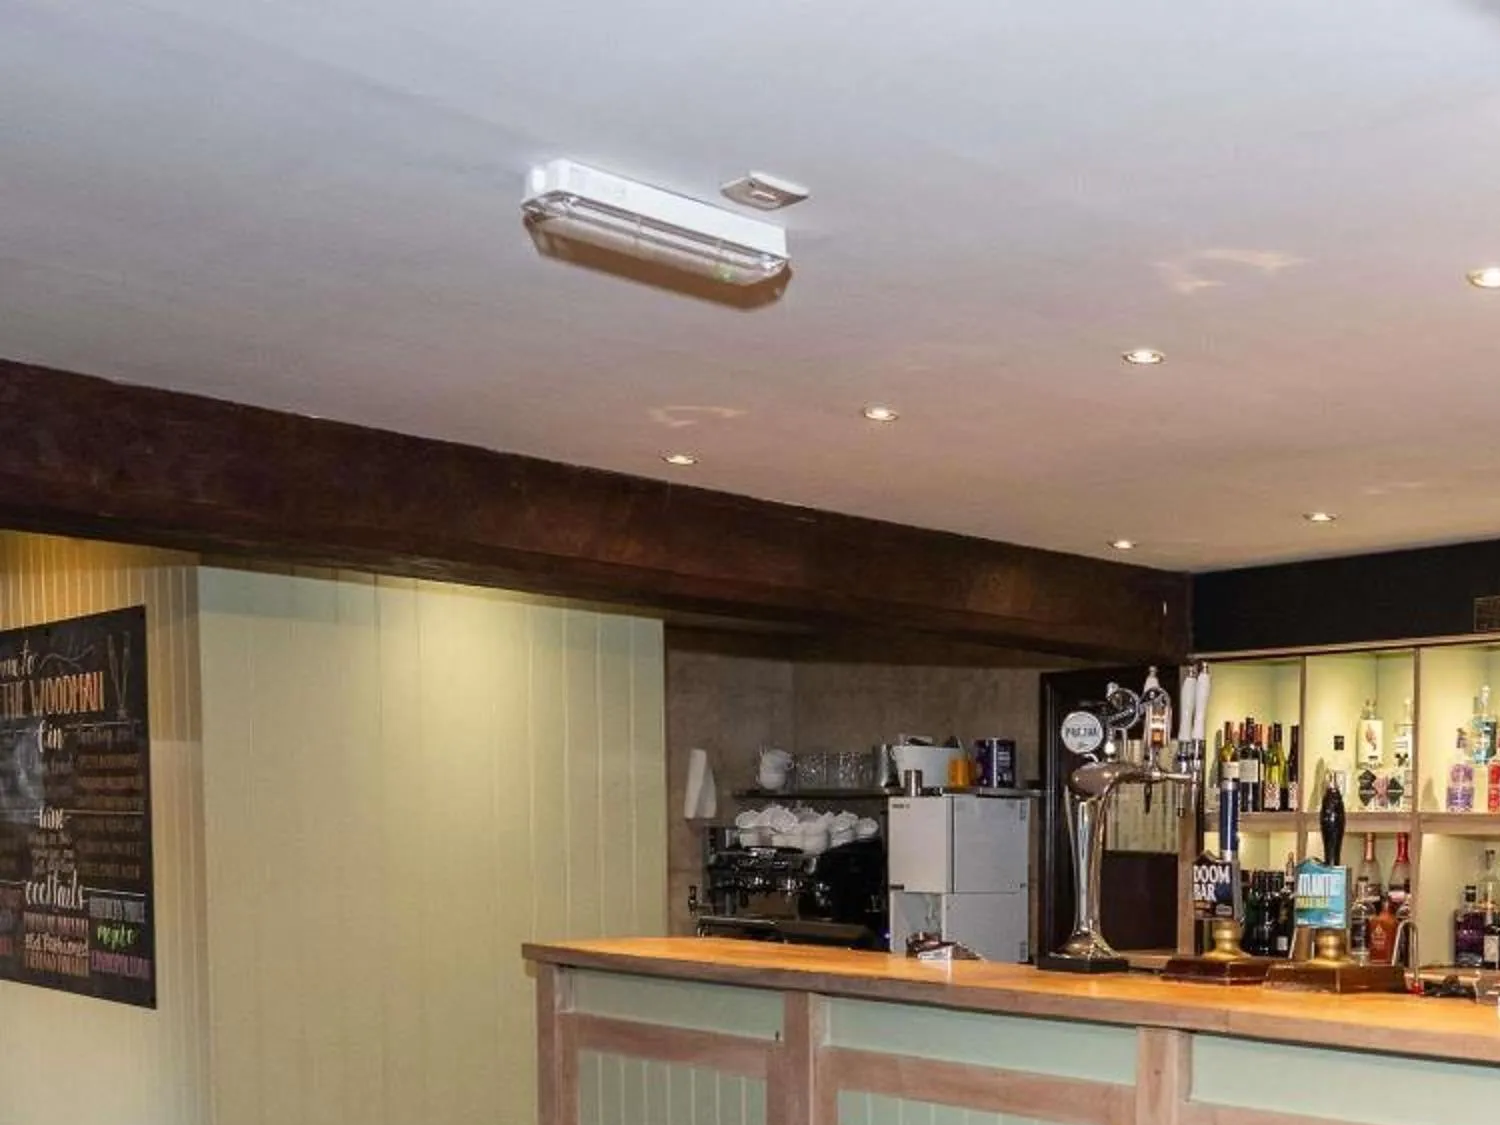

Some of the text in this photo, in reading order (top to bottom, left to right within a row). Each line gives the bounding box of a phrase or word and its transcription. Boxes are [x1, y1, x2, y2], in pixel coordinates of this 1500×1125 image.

[29, 671, 104, 717] WOODMAN
[1193, 865, 1231, 884] DOOM
[1193, 884, 1217, 902] BAR
